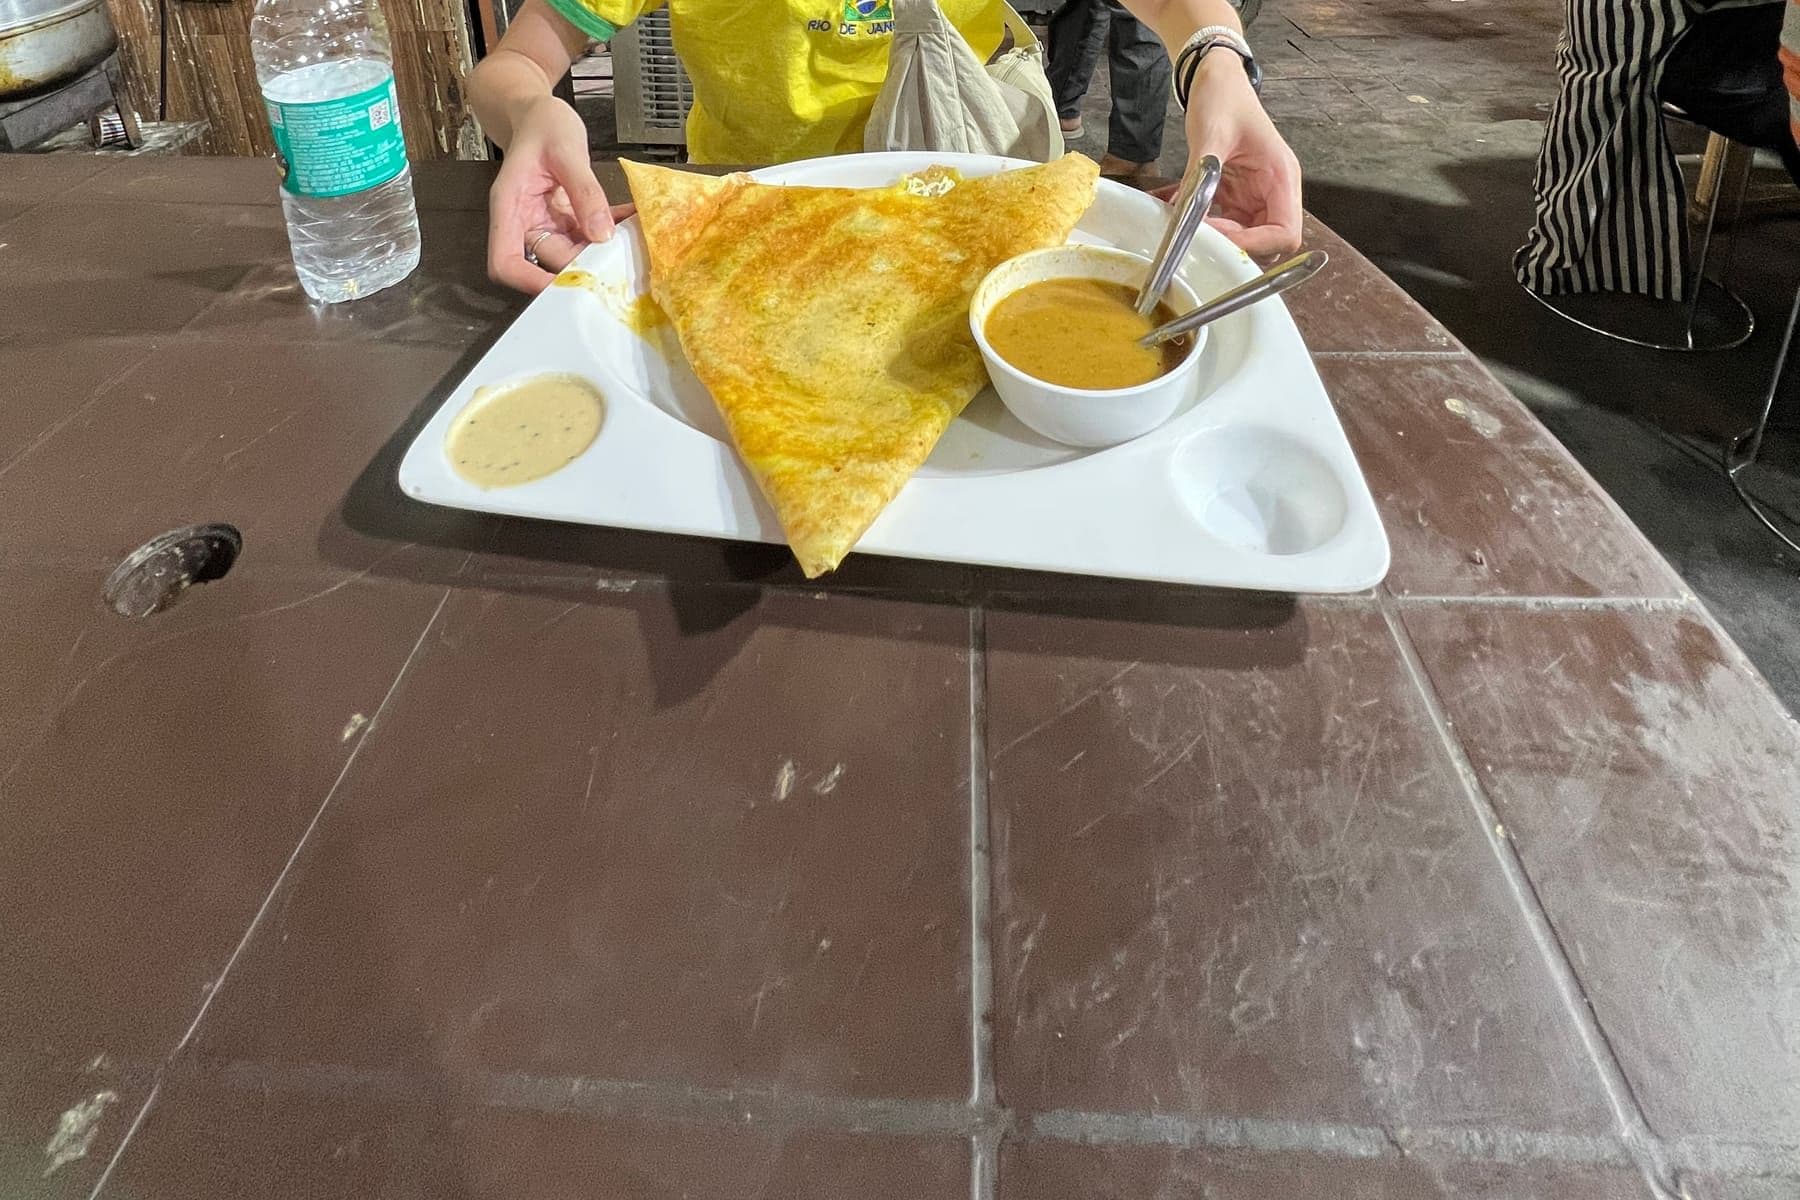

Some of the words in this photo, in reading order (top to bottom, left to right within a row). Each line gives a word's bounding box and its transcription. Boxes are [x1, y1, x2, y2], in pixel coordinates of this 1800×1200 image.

[807, 20, 832, 32] RIO
[840, 22, 856, 35] DE
[867, 20, 895, 35] JAN
